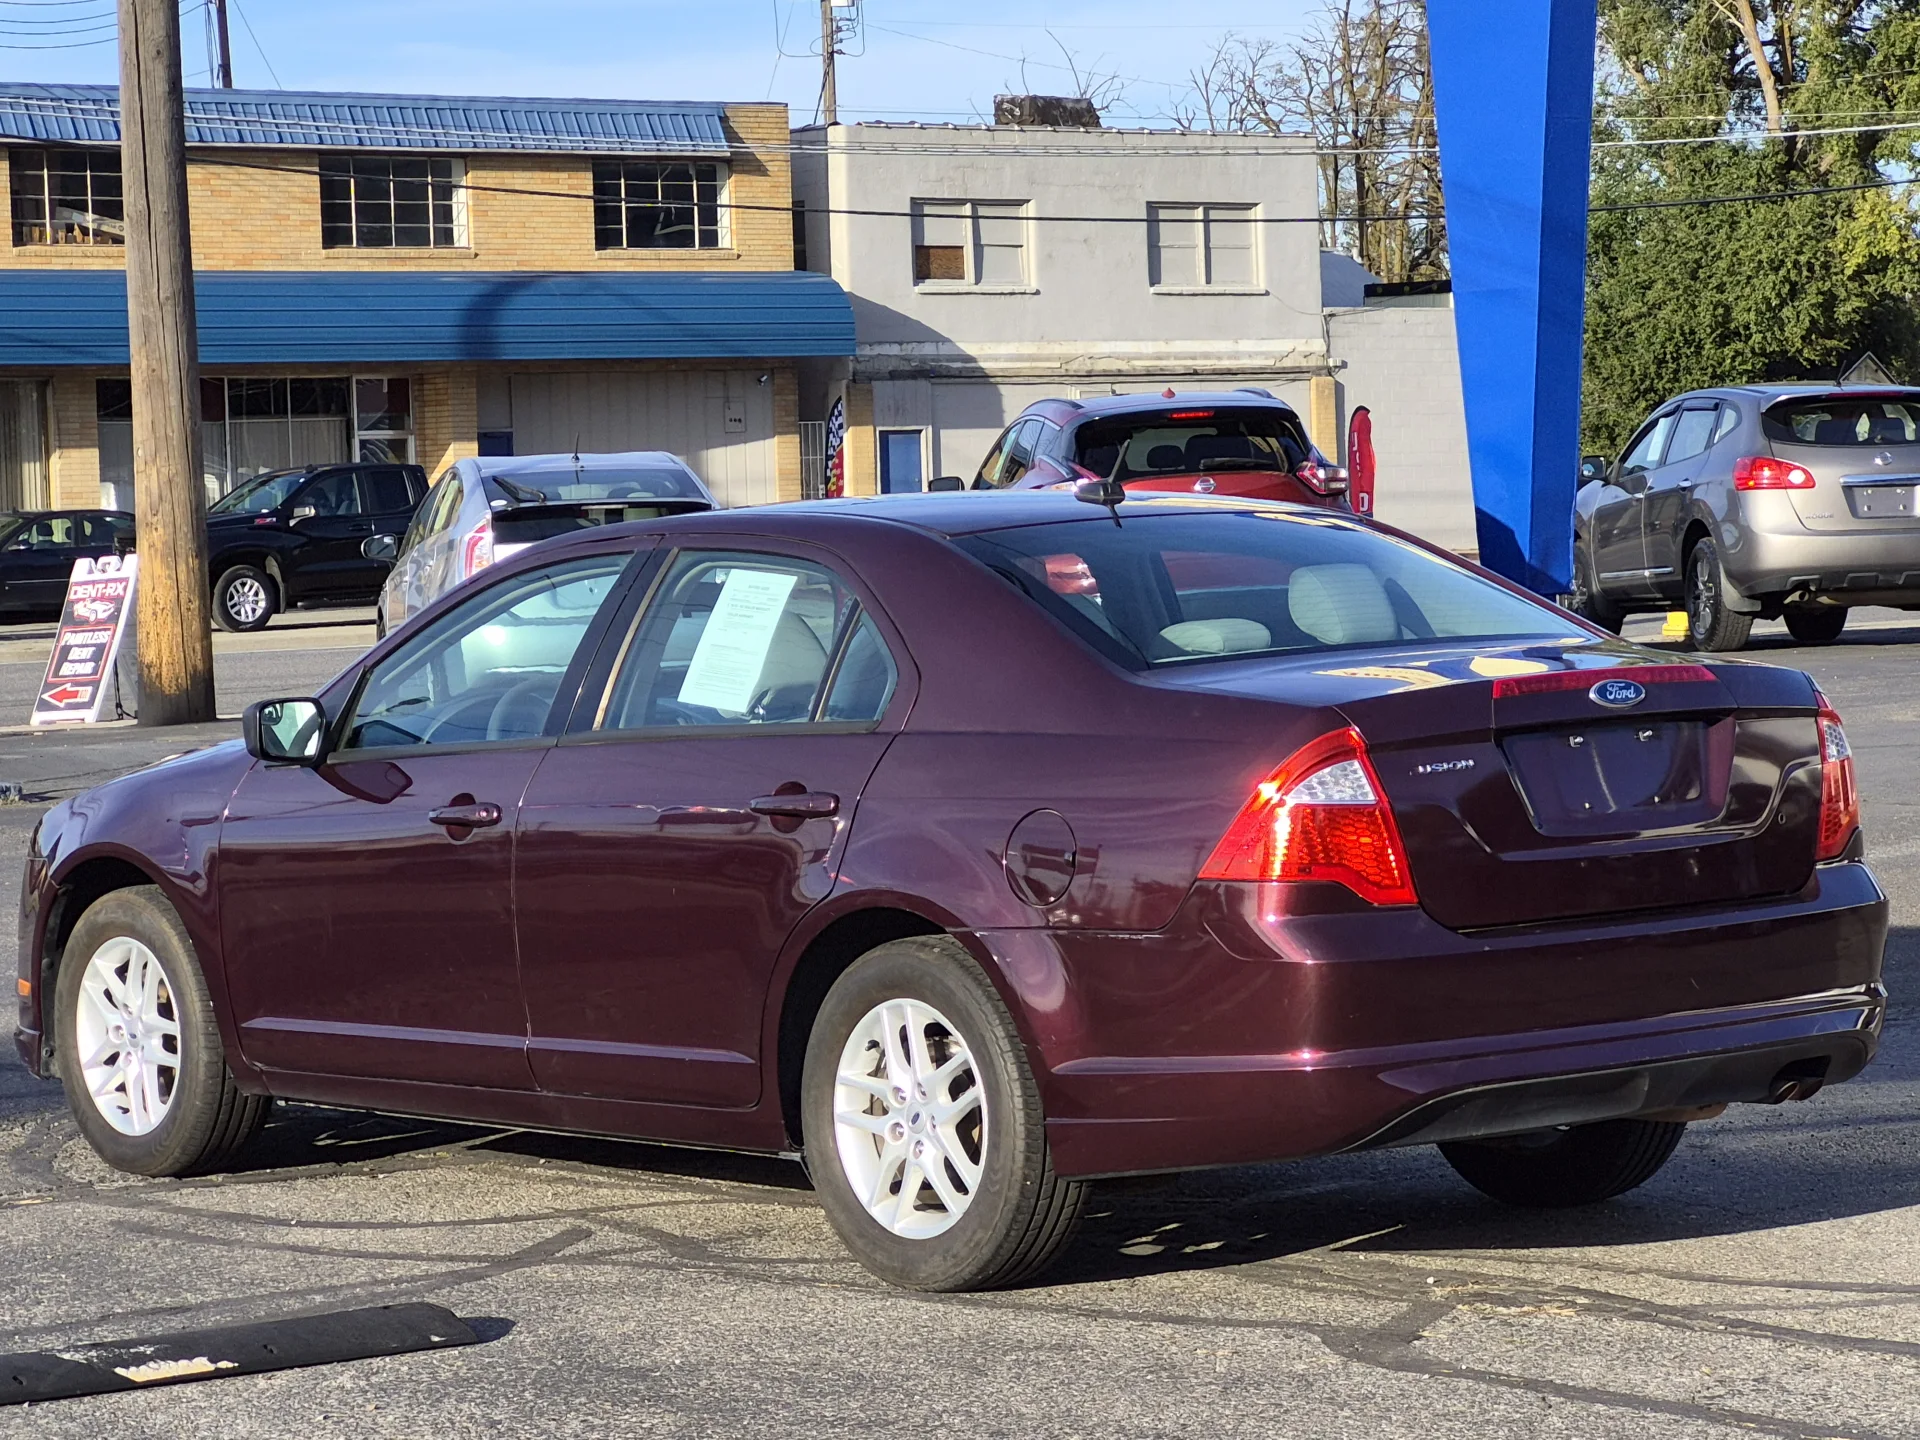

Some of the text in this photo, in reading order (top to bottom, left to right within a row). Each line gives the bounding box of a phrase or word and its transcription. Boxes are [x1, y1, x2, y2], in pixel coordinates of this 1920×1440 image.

[70, 582, 126, 599] DENT-RX
[61, 631, 111, 645] PAINTLESS
[67, 647, 96, 660] DENT
[59, 662, 96, 676] REPAIR
[1606, 682, 1636, 700] Ford
[1409, 759, 1475, 776] USION
